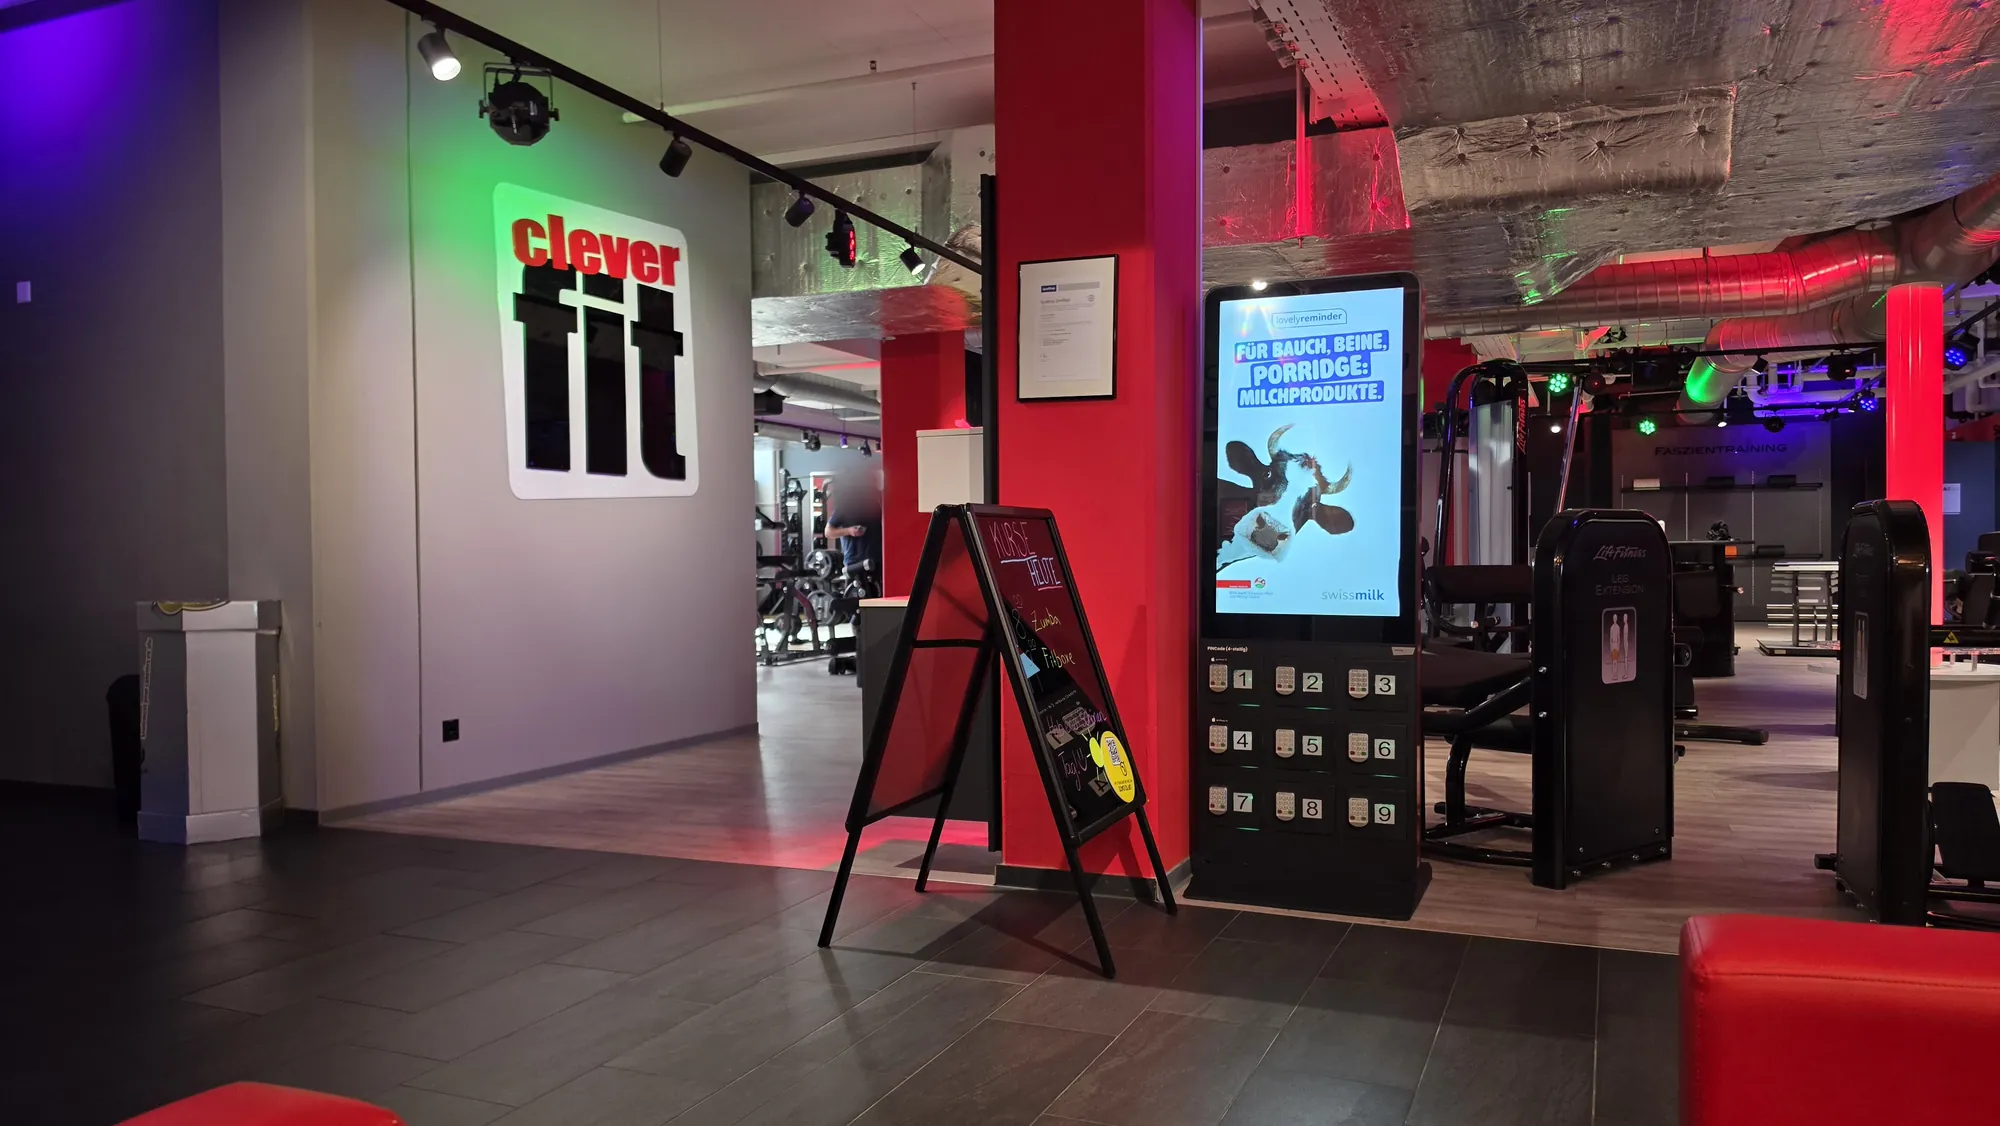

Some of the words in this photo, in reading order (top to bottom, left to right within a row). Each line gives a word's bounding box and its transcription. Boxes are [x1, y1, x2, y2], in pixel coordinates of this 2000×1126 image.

[511, 213, 680, 287] clever
[1276, 312, 1343, 325] lovelyreminder
[1236, 342, 1268, 361] FÜR
[1272, 337, 1331, 358] BAUCH,
[1334, 332, 1387, 352] BEINE,
[513, 258, 687, 481] fit
[1253, 354, 1369, 387] PORRIDGE:
[1239, 383, 1383, 407] MILCHPRODUKTE.
[1655, 443, 1788, 456] FASZIENTRAINING
[988, 520, 1036, 558] KURSE
[1026, 557, 1061, 587] HEUTE
[1321, 589, 1385, 601] swissmilk
[1238, 671, 1247, 687] 1
[1306, 674, 1319, 690] 2
[1379, 677, 1391, 693] 3
[1236, 733, 1248, 748] 4
[1306, 738, 1319, 753] 5
[1379, 741, 1391, 757] 6
[1237, 795, 1249, 810] 7
[1306, 801, 1319, 816] 8
[1379, 806, 1391, 822] 9
